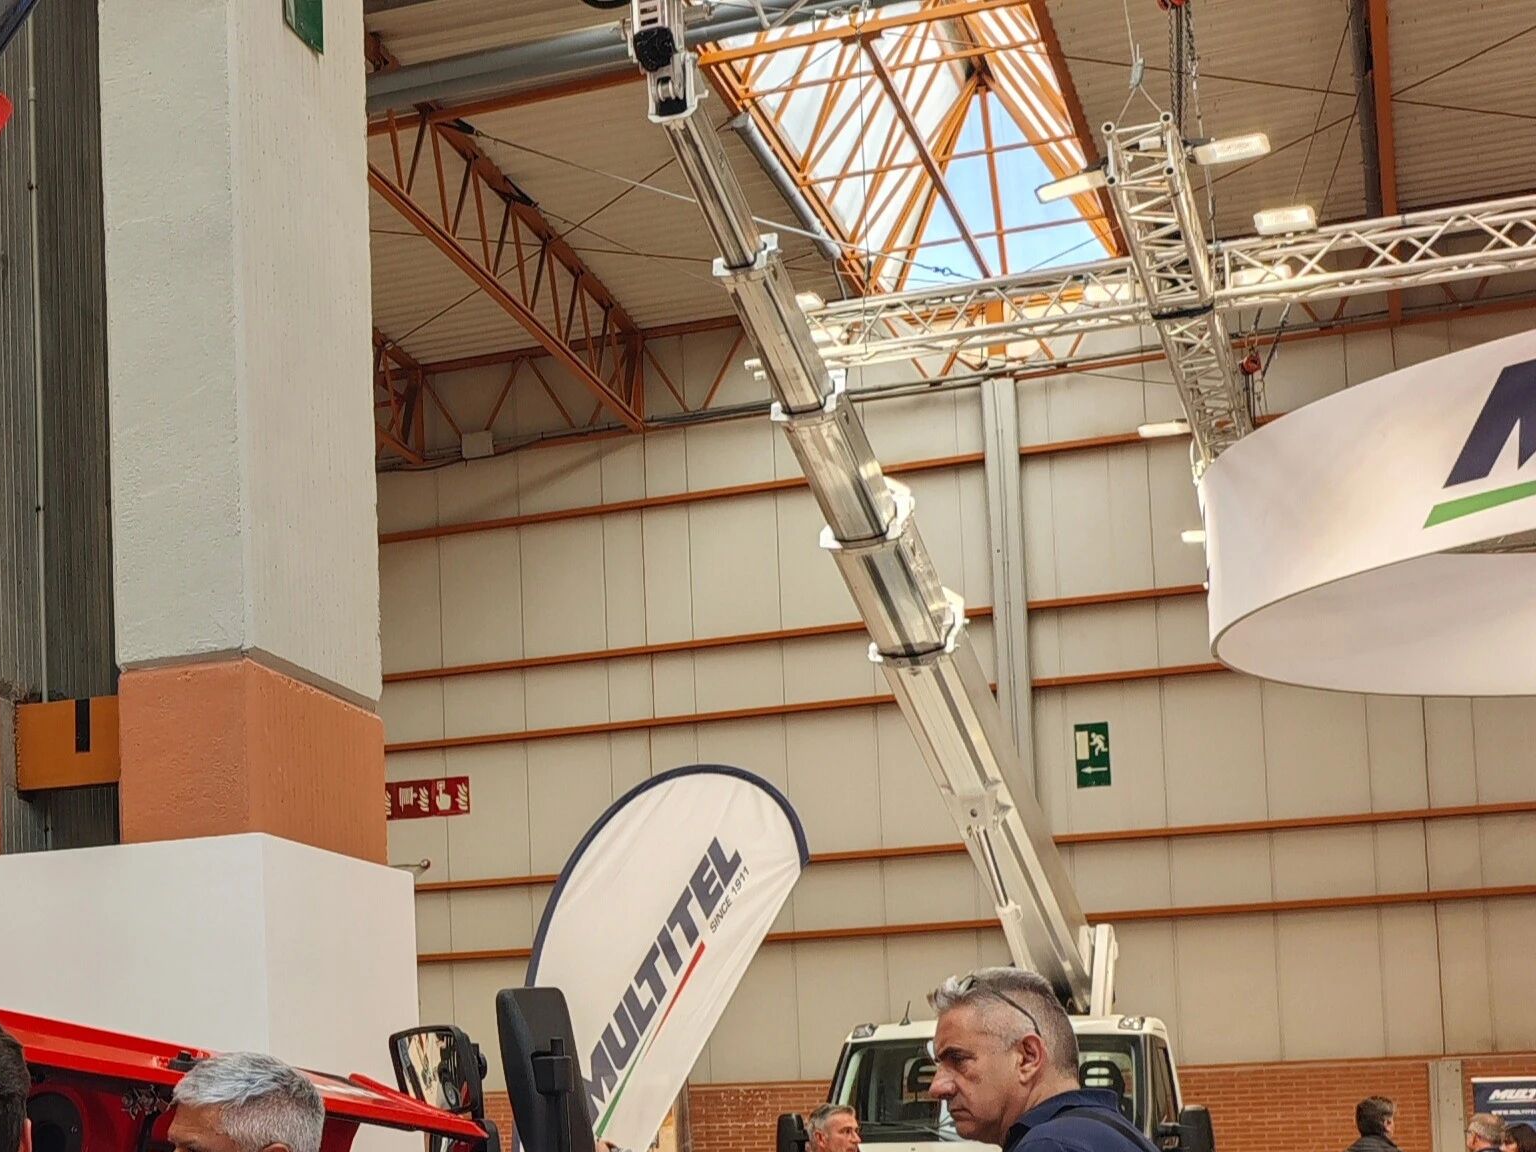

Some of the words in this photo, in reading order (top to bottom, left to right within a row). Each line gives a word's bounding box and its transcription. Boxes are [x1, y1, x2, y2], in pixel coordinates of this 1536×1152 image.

[582, 836, 742, 1123] MULTITEL
[710, 895, 732, 933] SINCE
[731, 866, 750, 895] 1911
